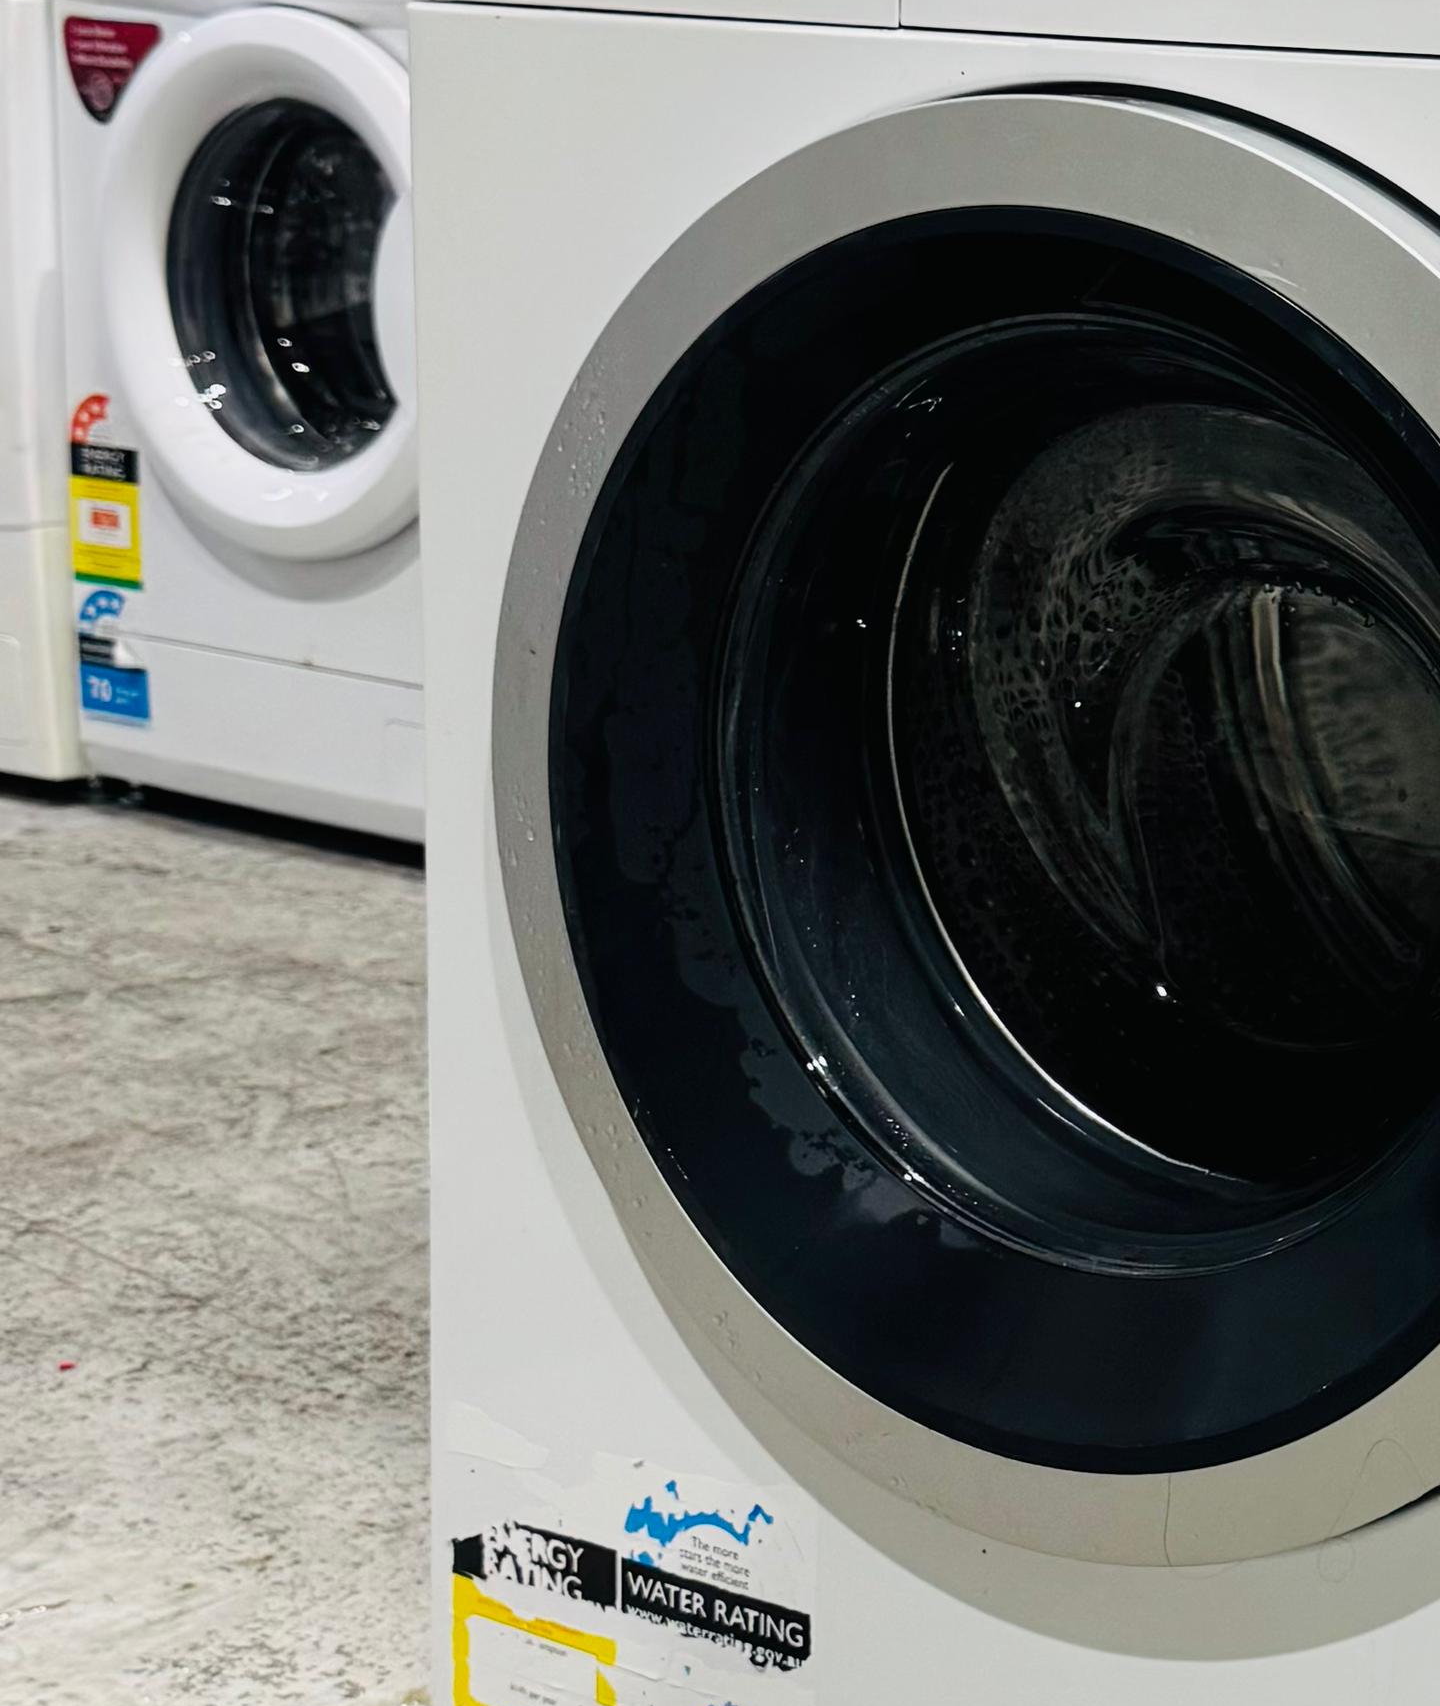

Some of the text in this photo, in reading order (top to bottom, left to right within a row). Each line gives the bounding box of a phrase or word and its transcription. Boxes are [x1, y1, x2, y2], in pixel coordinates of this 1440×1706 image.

[484, 1521, 584, 1573] ENERGY
[692, 1535, 740, 1561] The more
[705, 1554, 722, 1569] the
[724, 1560, 751, 1578] more
[484, 1550, 583, 1601] RATING
[681, 1562, 709, 1577] water
[626, 1571, 804, 1648] WATER RATING
